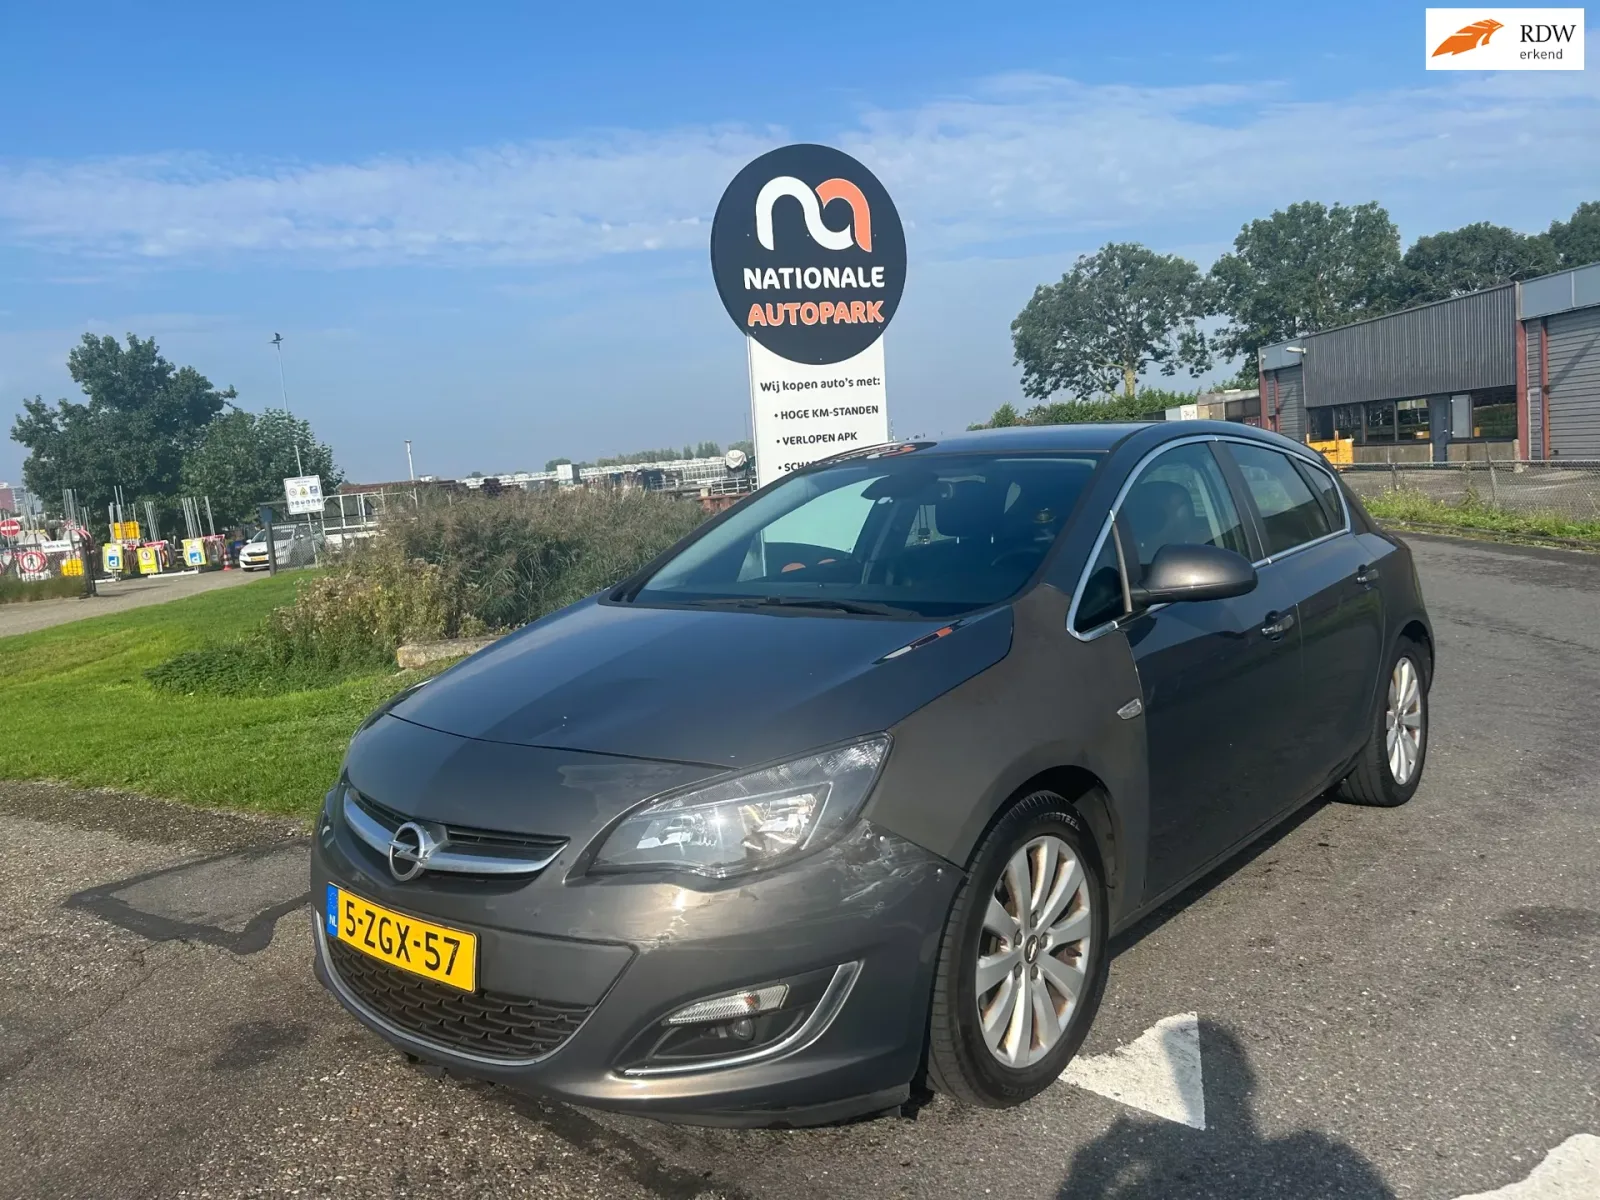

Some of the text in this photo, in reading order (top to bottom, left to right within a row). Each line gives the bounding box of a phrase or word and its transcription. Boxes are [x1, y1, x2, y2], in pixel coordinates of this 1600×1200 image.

[743, 266, 885, 290] NATIONALE
[747, 300, 885, 327] AUTOPARK
[760, 376, 881, 393] Wij kopen auto's met:
[780, 405, 879, 420] HOGE KM-STANDEN
[782, 431, 858, 446] VERLOPEN APK
[329, 914, 338, 928] NL
[345, 900, 461, 976] 5-ZGX-57
